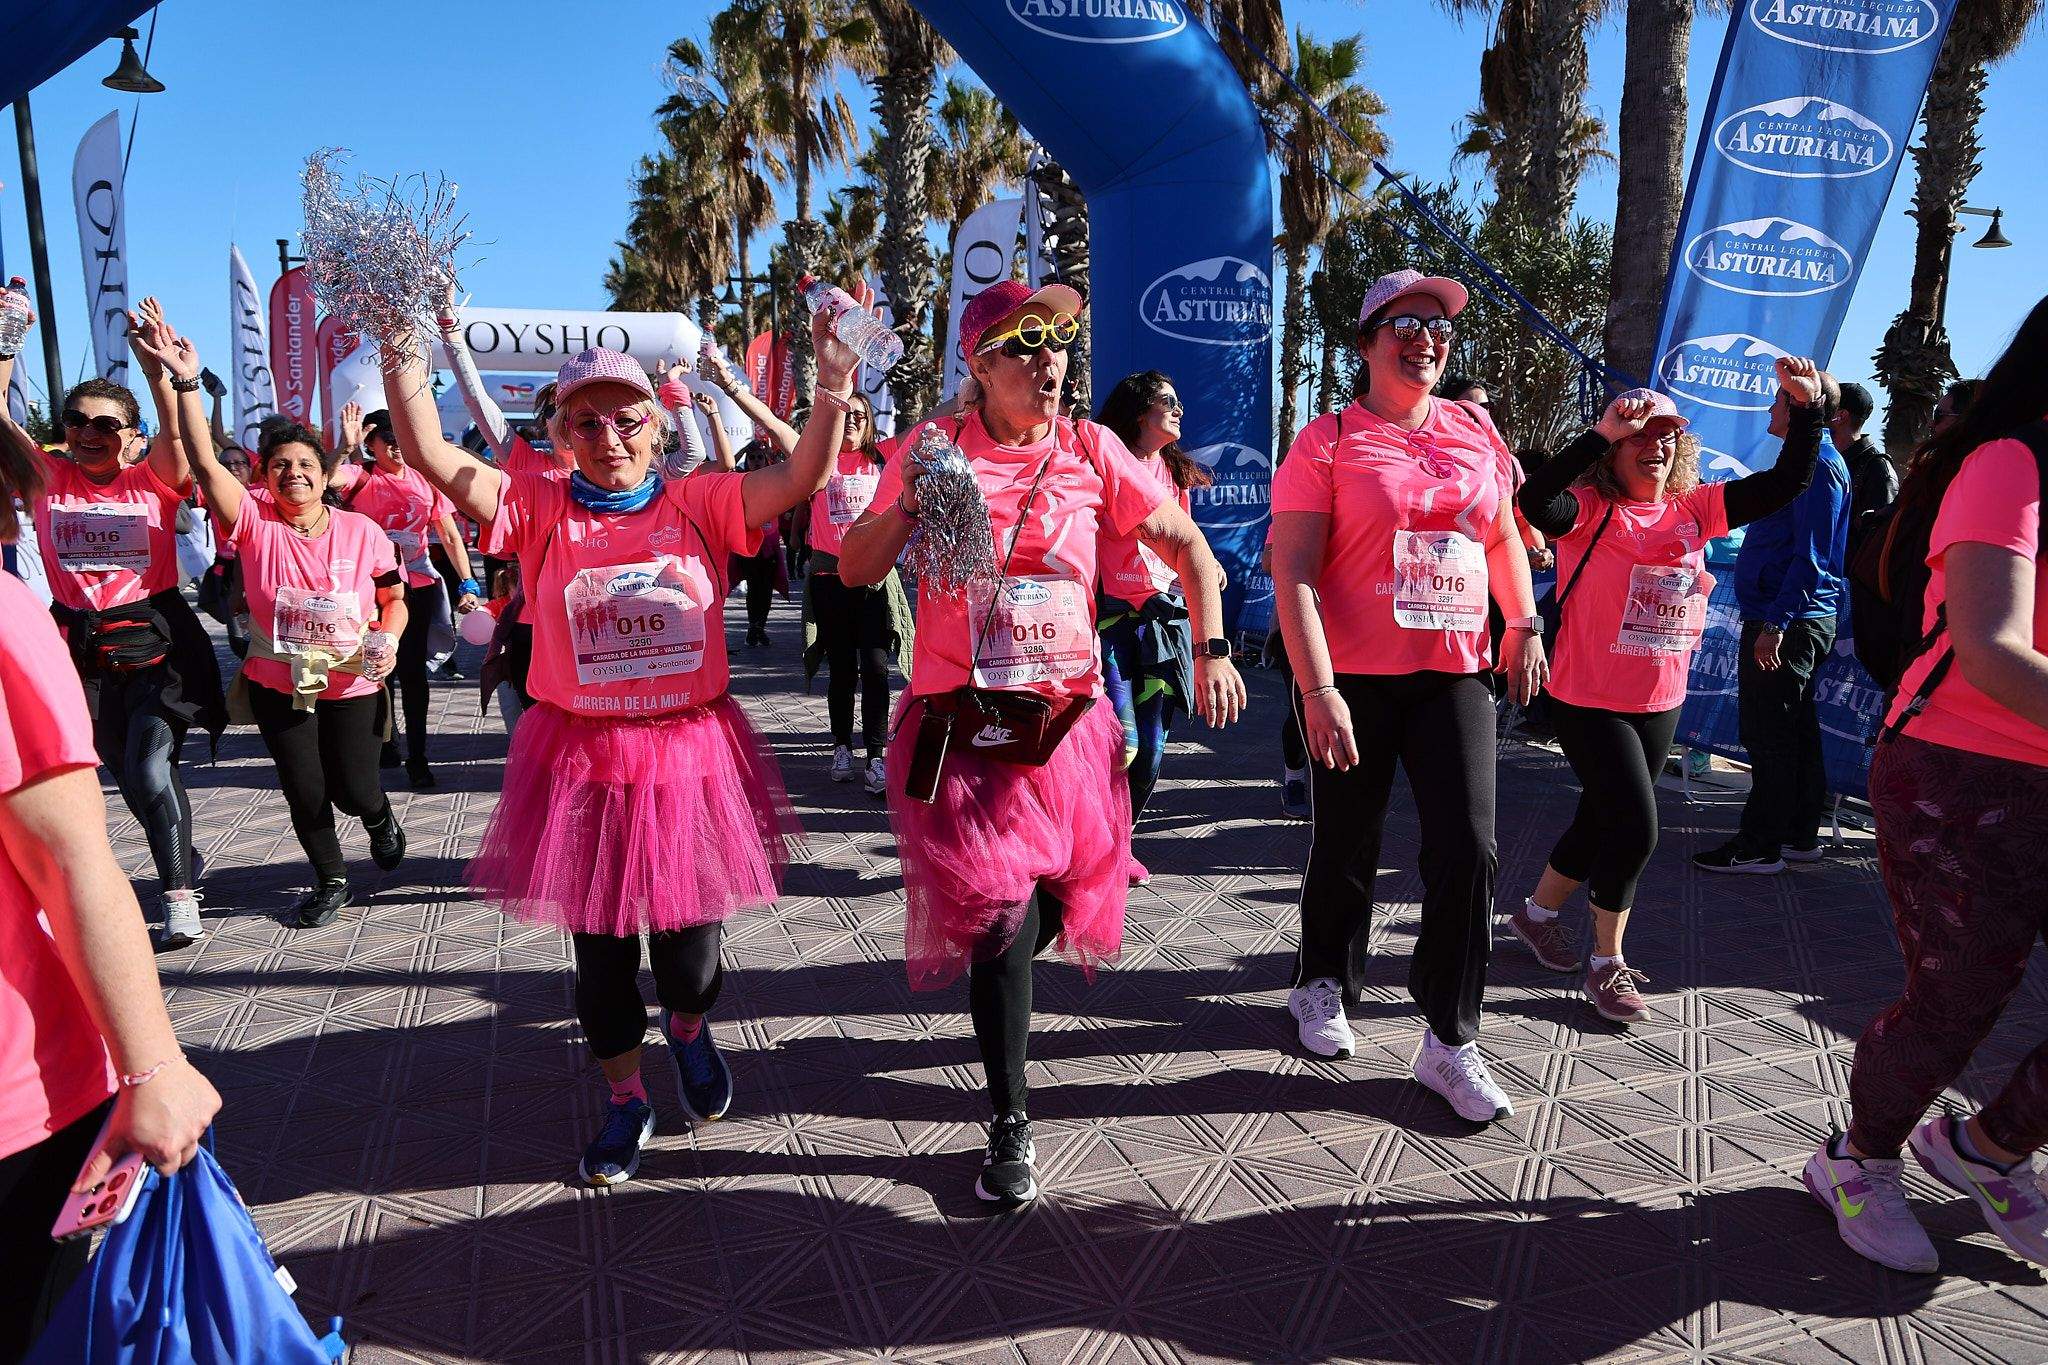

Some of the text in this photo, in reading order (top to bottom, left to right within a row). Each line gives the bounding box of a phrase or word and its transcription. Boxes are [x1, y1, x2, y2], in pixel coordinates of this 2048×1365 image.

[1761, 0, 1919, 38] ASTURIANA
[1758, 121, 1876, 143] CENTRAL LECHERA
[1725, 121, 1875, 167] ASTURIANA
[1725, 240, 1836, 260] CENTRAL LECHERA
[1695, 240, 1836, 283] ASTURIANA
[86, 180, 129, 382] YSHO
[1181, 286, 1236, 296] CENTRAL
[285, 293, 303, 391] Santander
[464, 321, 630, 355] OYSHO
[1694, 354, 1774, 373] CENTRAL LECH
[775, 349, 795, 417] Santander
[1667, 354, 1782, 397] ASTURIAN
[845, 495, 865, 504] 016
[85, 530, 120, 543] 016
[1432, 575, 1465, 592] 016
[1656, 604, 1687, 618] 016
[304, 620, 336, 634] 016
[616, 613, 666, 636] 016
[1012, 622, 1057, 642] 016
[1628, 633, 1657, 643] OYSHO
[592, 653, 621, 662] CARRERA
[620, 651, 629, 659] DE
[629, 650, 638, 658] LA
[639, 648, 659, 657] MUJER
[664, 644, 692, 654] VALENCIA
[1022, 645, 1044, 654] 3289
[1609, 643, 1650, 657] CARRERA
[592, 658, 696, 676] OYSHO Santander
[988, 659, 1014, 667] CARRERA
[987, 669, 1024, 681] OYSHO
[573, 692, 691, 711] CARRERA DE LA MUJE
